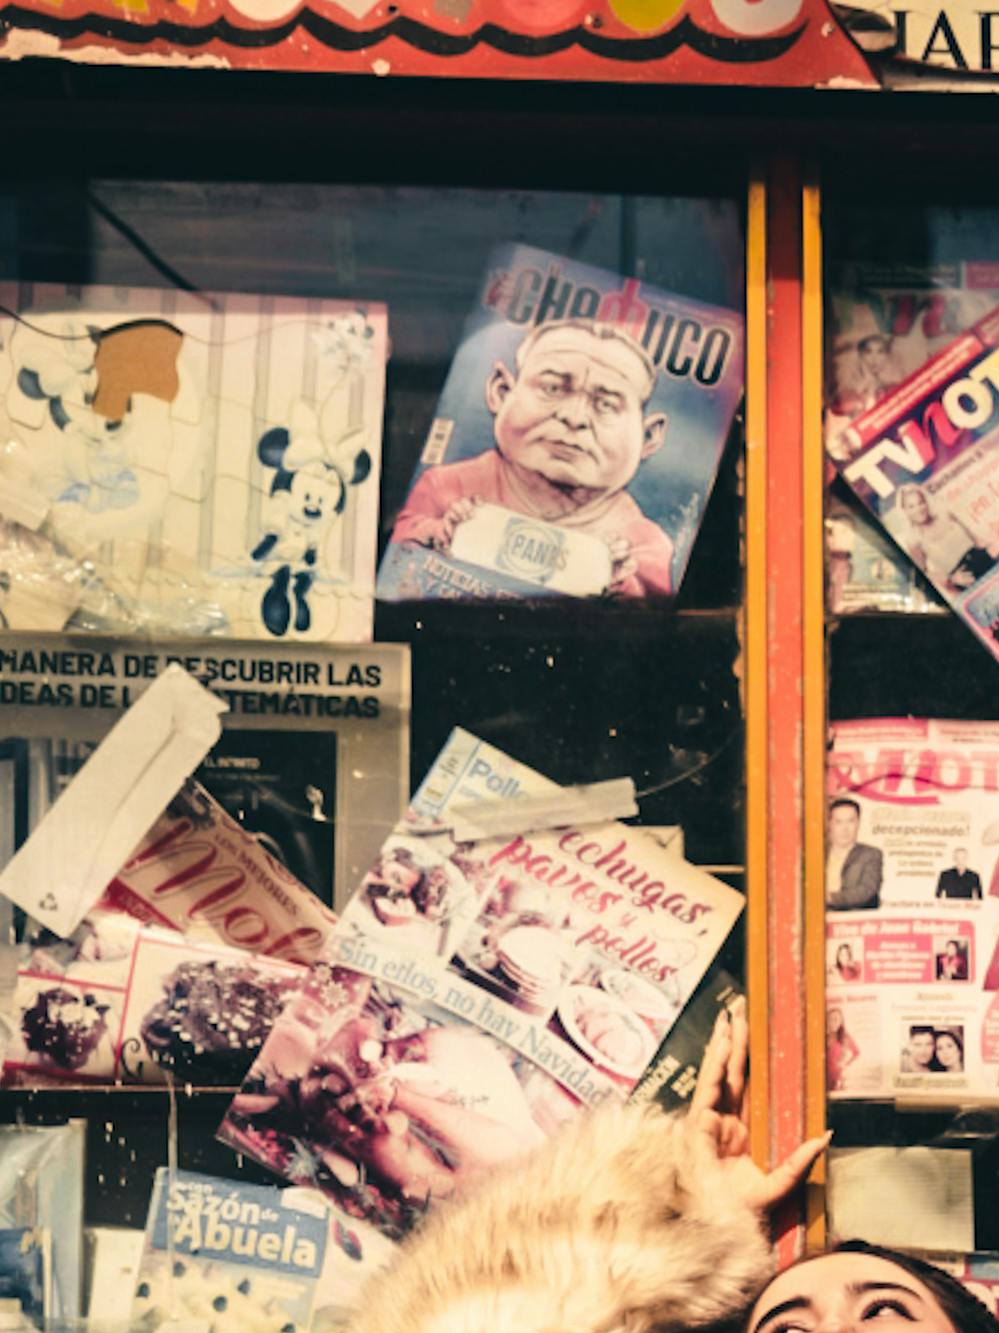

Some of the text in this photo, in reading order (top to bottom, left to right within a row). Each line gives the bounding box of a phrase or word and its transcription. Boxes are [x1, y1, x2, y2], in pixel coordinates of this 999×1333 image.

[80, 683, 116, 709] DE
[124, 653, 158, 679] DE
[328, 662, 382, 688] LAS
[488, 835, 622, 914] pavos
[557, 829, 713, 938] echugas,
[575, 921, 680, 984] pollos
[338, 938, 379, 974] Sin
[444, 983, 475, 1014] no
[477, 994, 520, 1040] hay
[518, 1025, 614, 1107] Navidad
[166, 1189, 262, 1226] Sazón
[173, 1202, 317, 1269] Abuela
